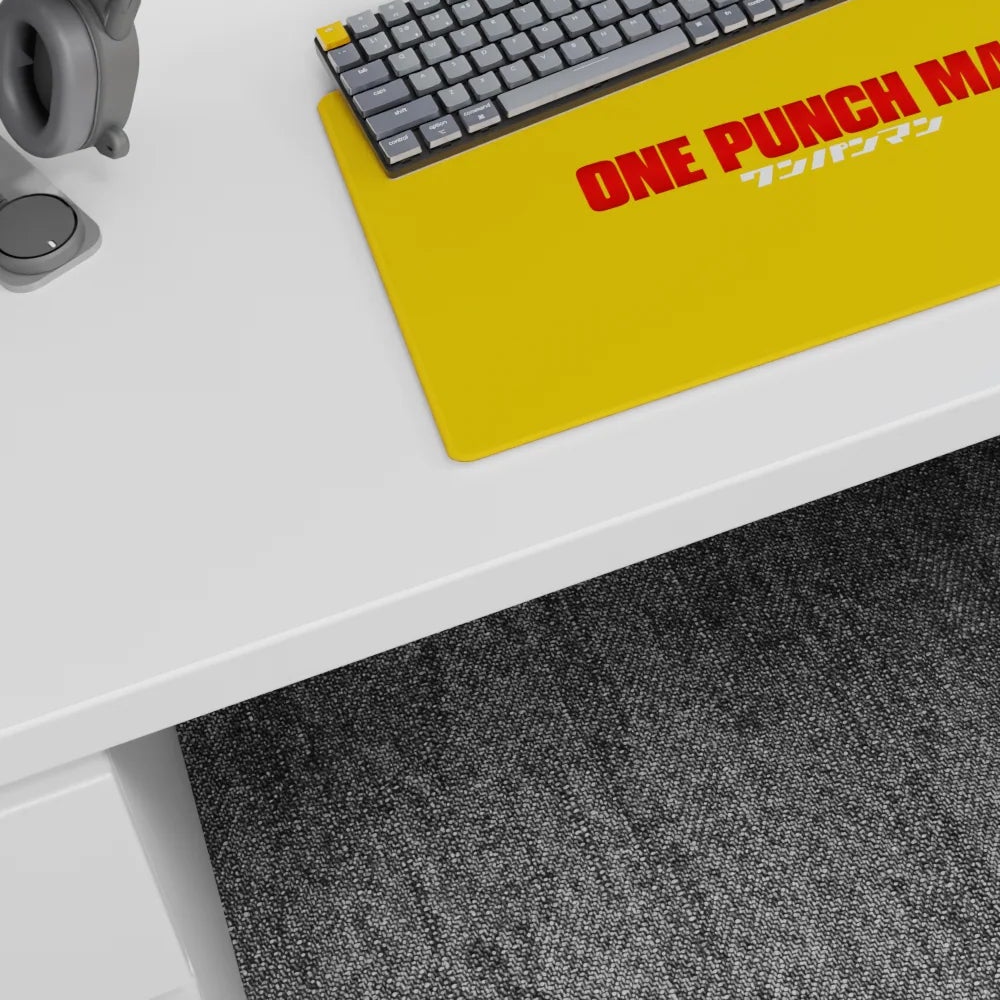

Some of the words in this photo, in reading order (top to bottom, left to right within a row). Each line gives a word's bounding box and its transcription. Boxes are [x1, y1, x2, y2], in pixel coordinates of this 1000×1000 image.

[576, 136, 707, 212] ONE
[703, 71, 921, 173] PUNCH
[740, 115, 943, 188] ワンパンマン
